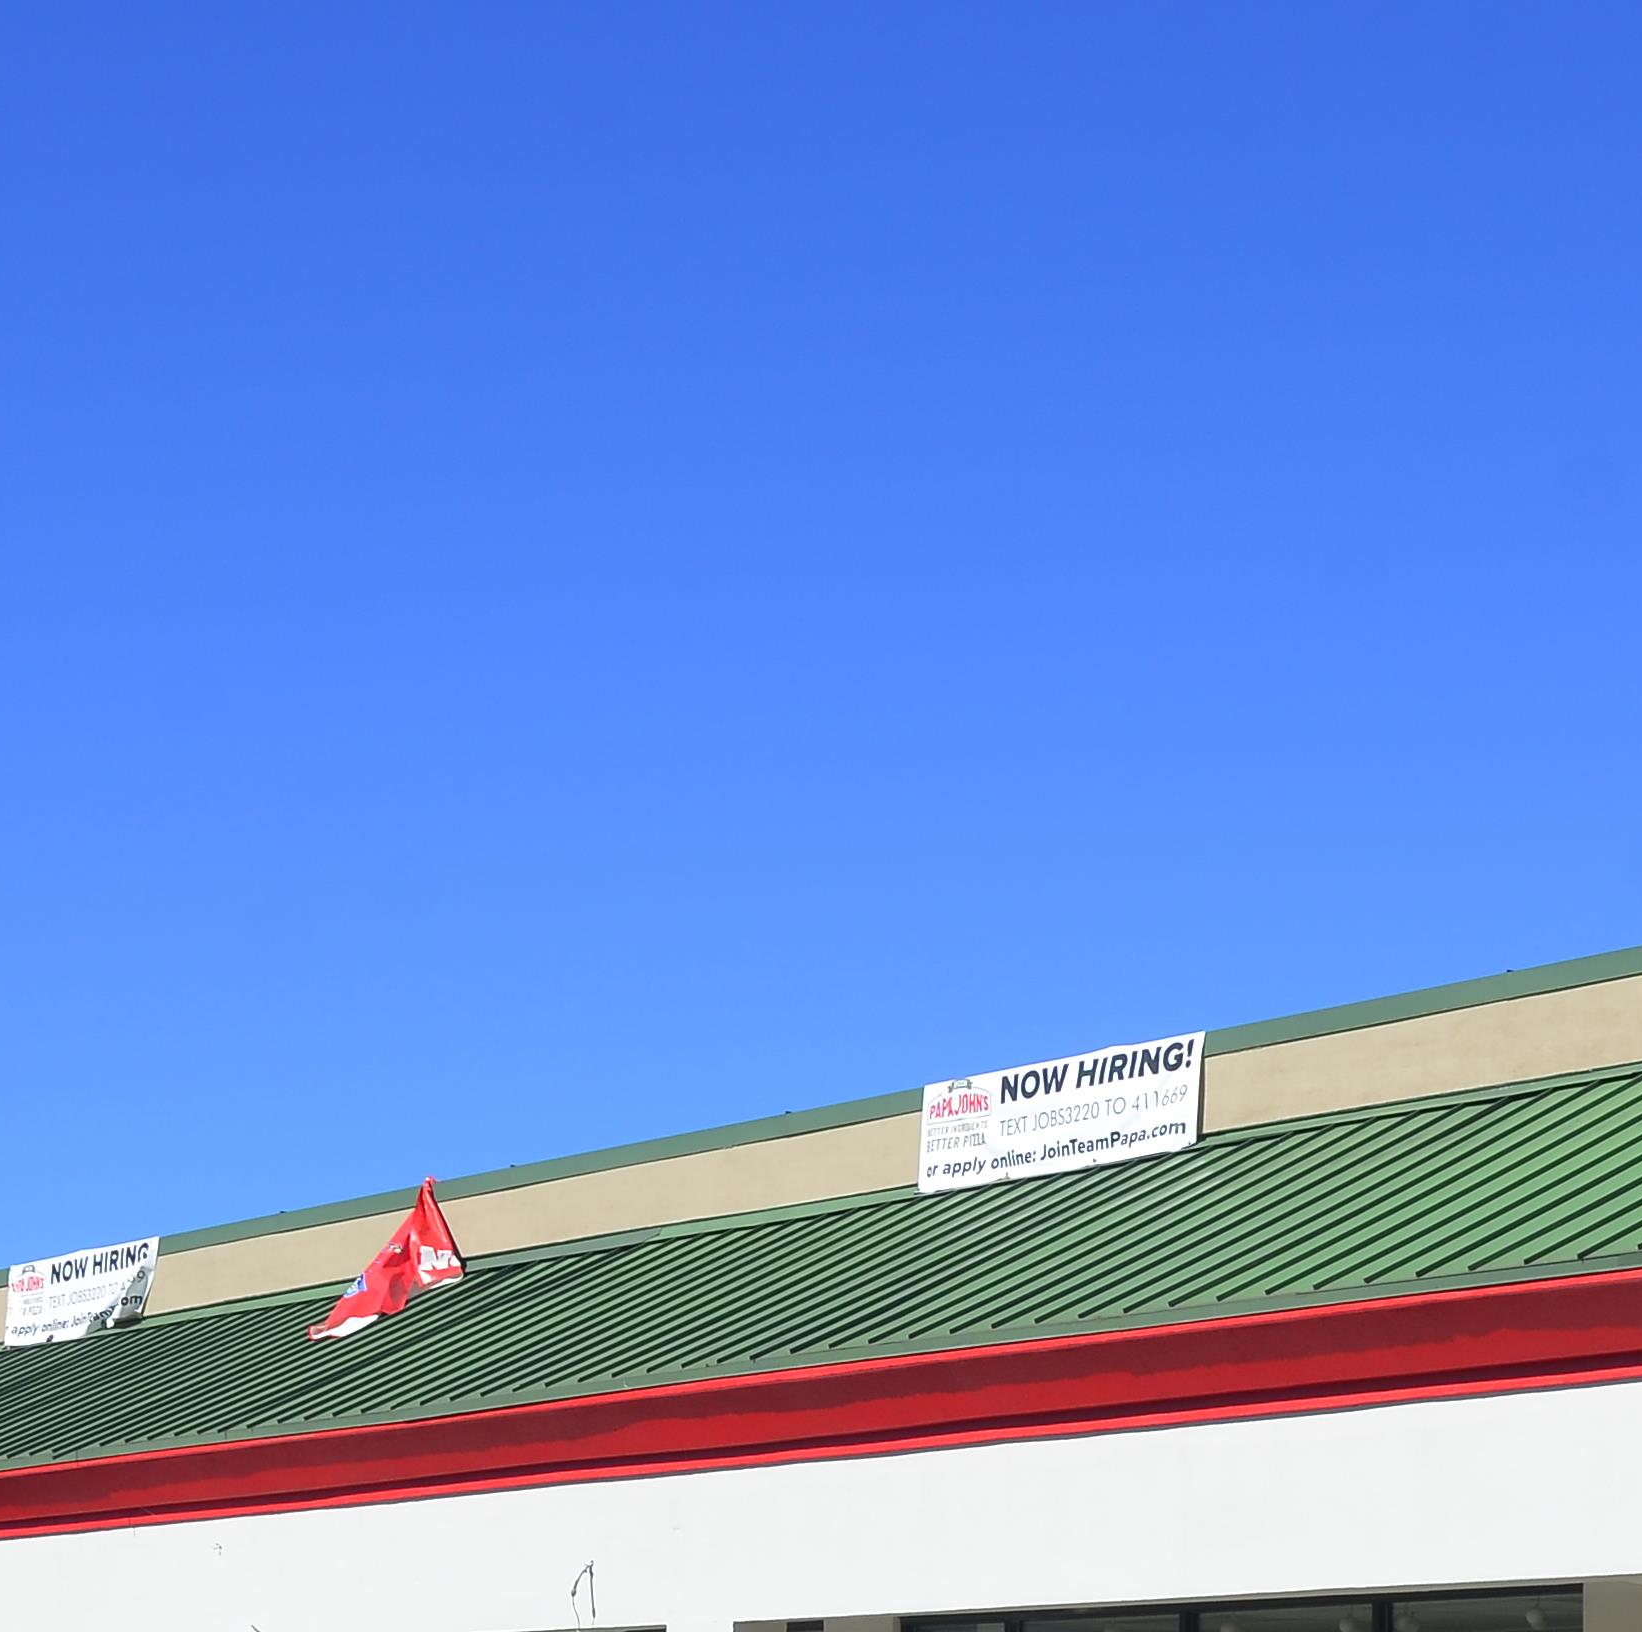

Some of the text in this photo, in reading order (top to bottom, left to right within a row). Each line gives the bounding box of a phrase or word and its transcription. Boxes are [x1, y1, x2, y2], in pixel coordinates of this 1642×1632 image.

[1000, 1039, 1195, 1105] NOW HIRING!
[929, 1093, 989, 1120] PAPA JOHN'S
[999, 1084, 1188, 1137] TEXT JOBS3220 TO 411669
[926, 1122, 1187, 1178] or apply online: JoinTeamPapa.com
[50, 1256, 89, 1285] NOW
[11, 1322, 40, 1337] apply
